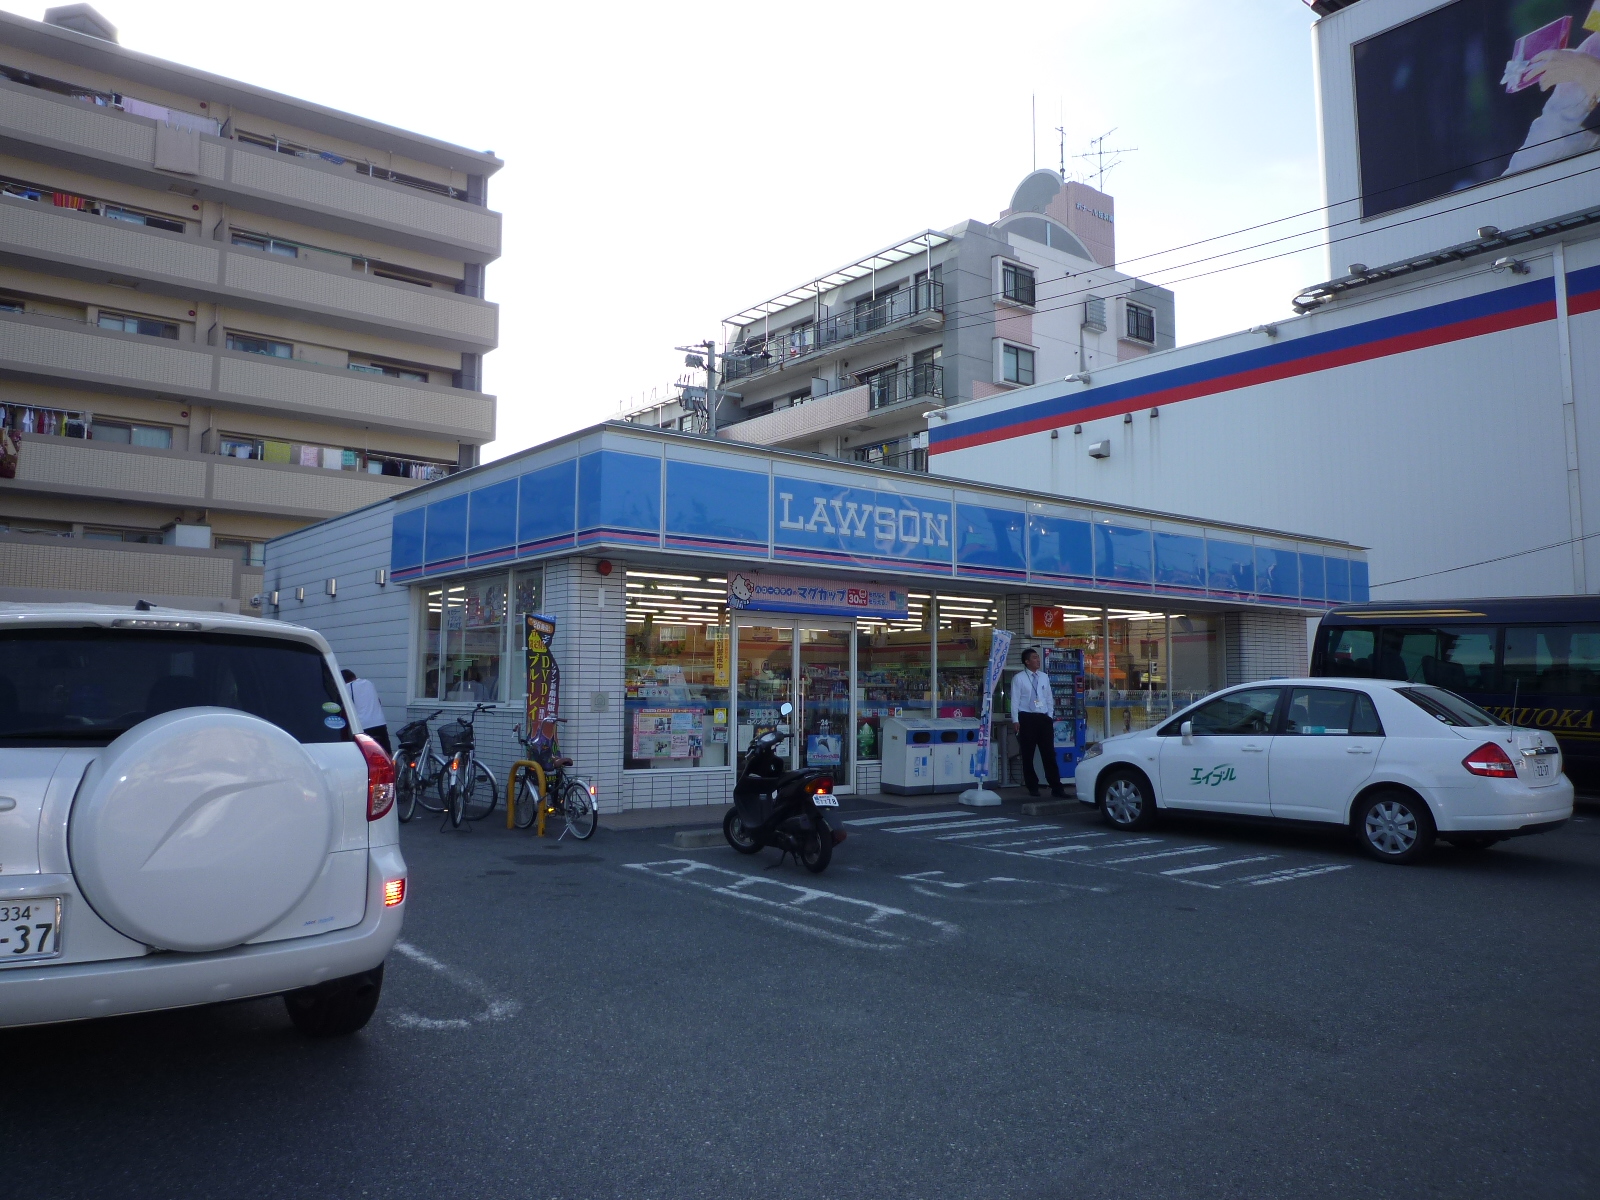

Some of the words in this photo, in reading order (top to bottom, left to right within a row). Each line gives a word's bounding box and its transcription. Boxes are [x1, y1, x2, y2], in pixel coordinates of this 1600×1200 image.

[779, 492, 949, 547] LAWSON
[529, 653, 540, 720] ブルーレイ
[1190, 764, 1237, 787] エイブル
[0, 905, 31, 922] 334
